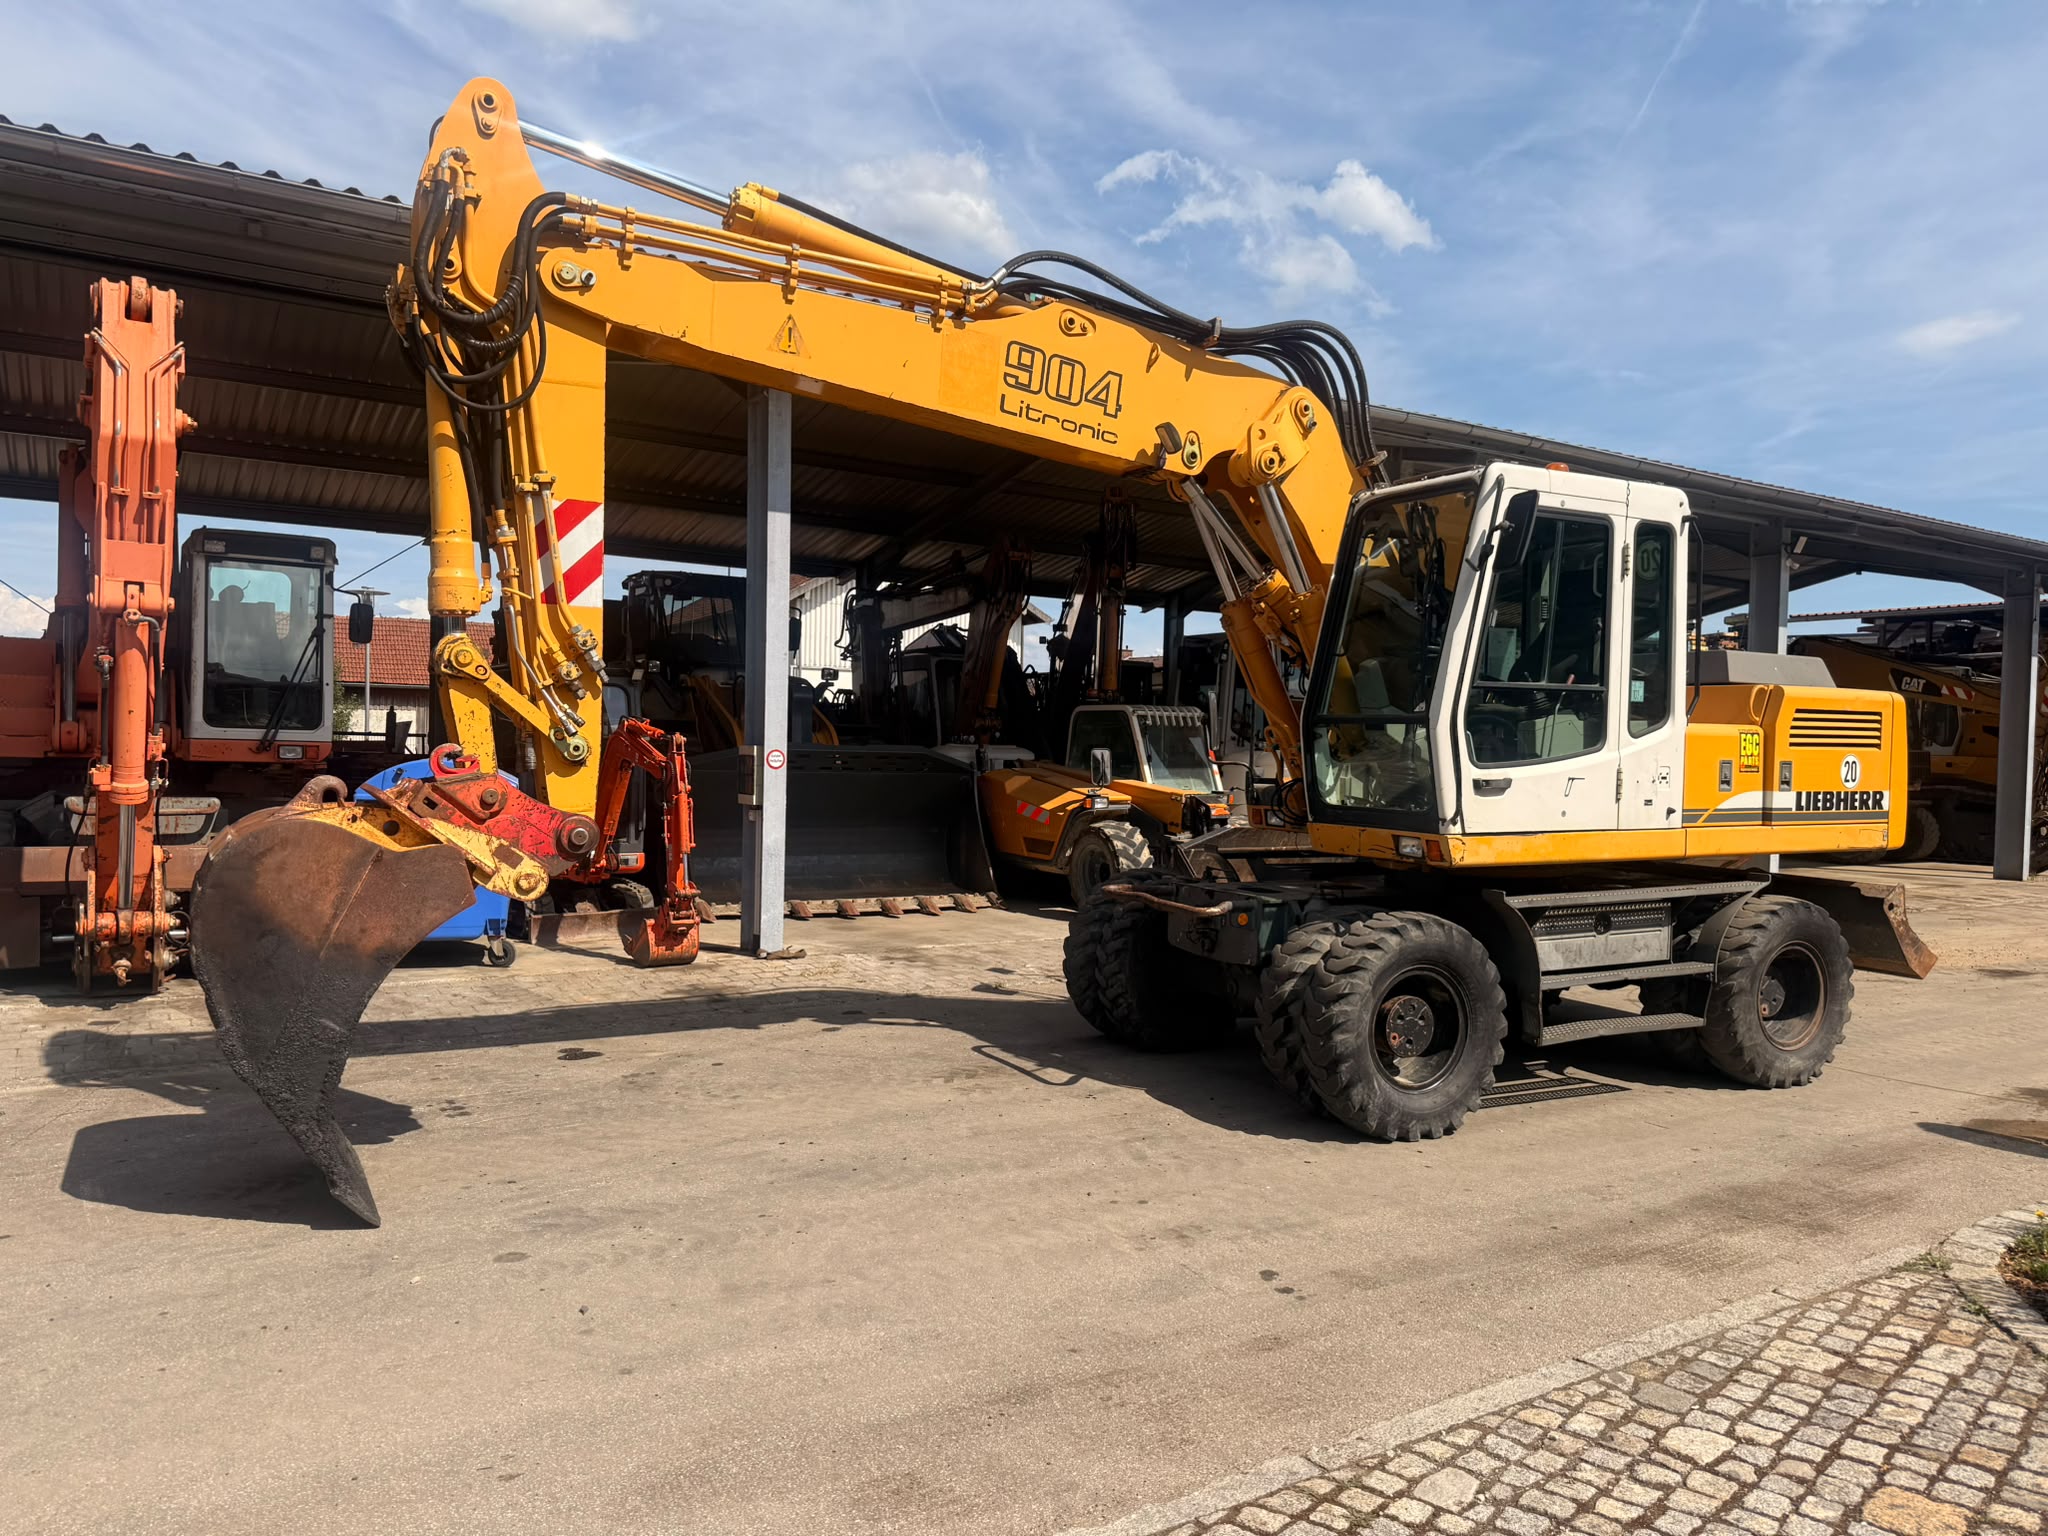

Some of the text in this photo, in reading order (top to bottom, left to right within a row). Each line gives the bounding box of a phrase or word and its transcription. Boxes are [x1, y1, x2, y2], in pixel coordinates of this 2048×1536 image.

[1003, 340, 1123, 419] 904
[1000, 393, 1118, 444] Litronic
[1901, 676, 1926, 692] CAT
[1844, 760, 1858, 783] 20
[1795, 791, 1884, 811] LIEBHERR
